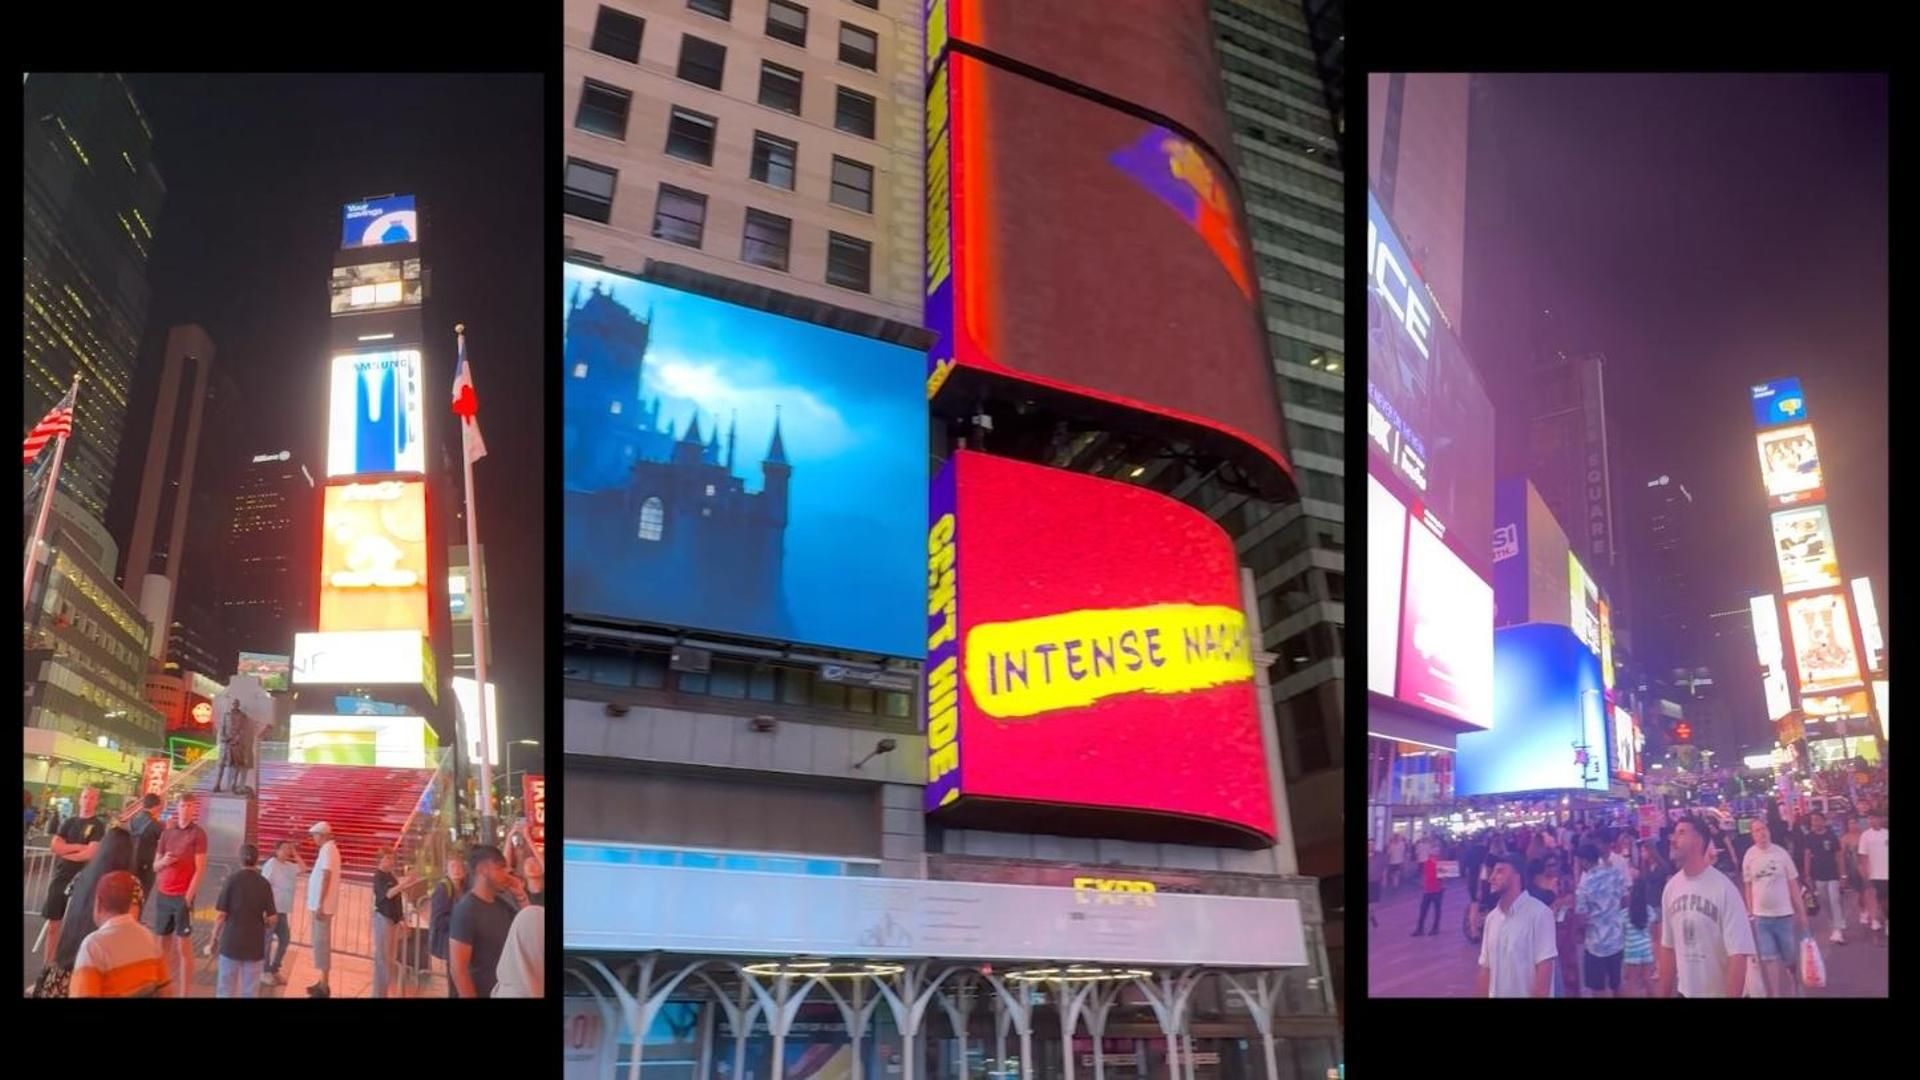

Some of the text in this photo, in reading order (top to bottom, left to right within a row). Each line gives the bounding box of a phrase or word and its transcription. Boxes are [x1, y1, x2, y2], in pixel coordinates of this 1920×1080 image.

[1587, 452, 1605, 555] SQUARE
[987, 627, 1167, 696] INTENSE
[927, 655, 959, 784] HIDE
